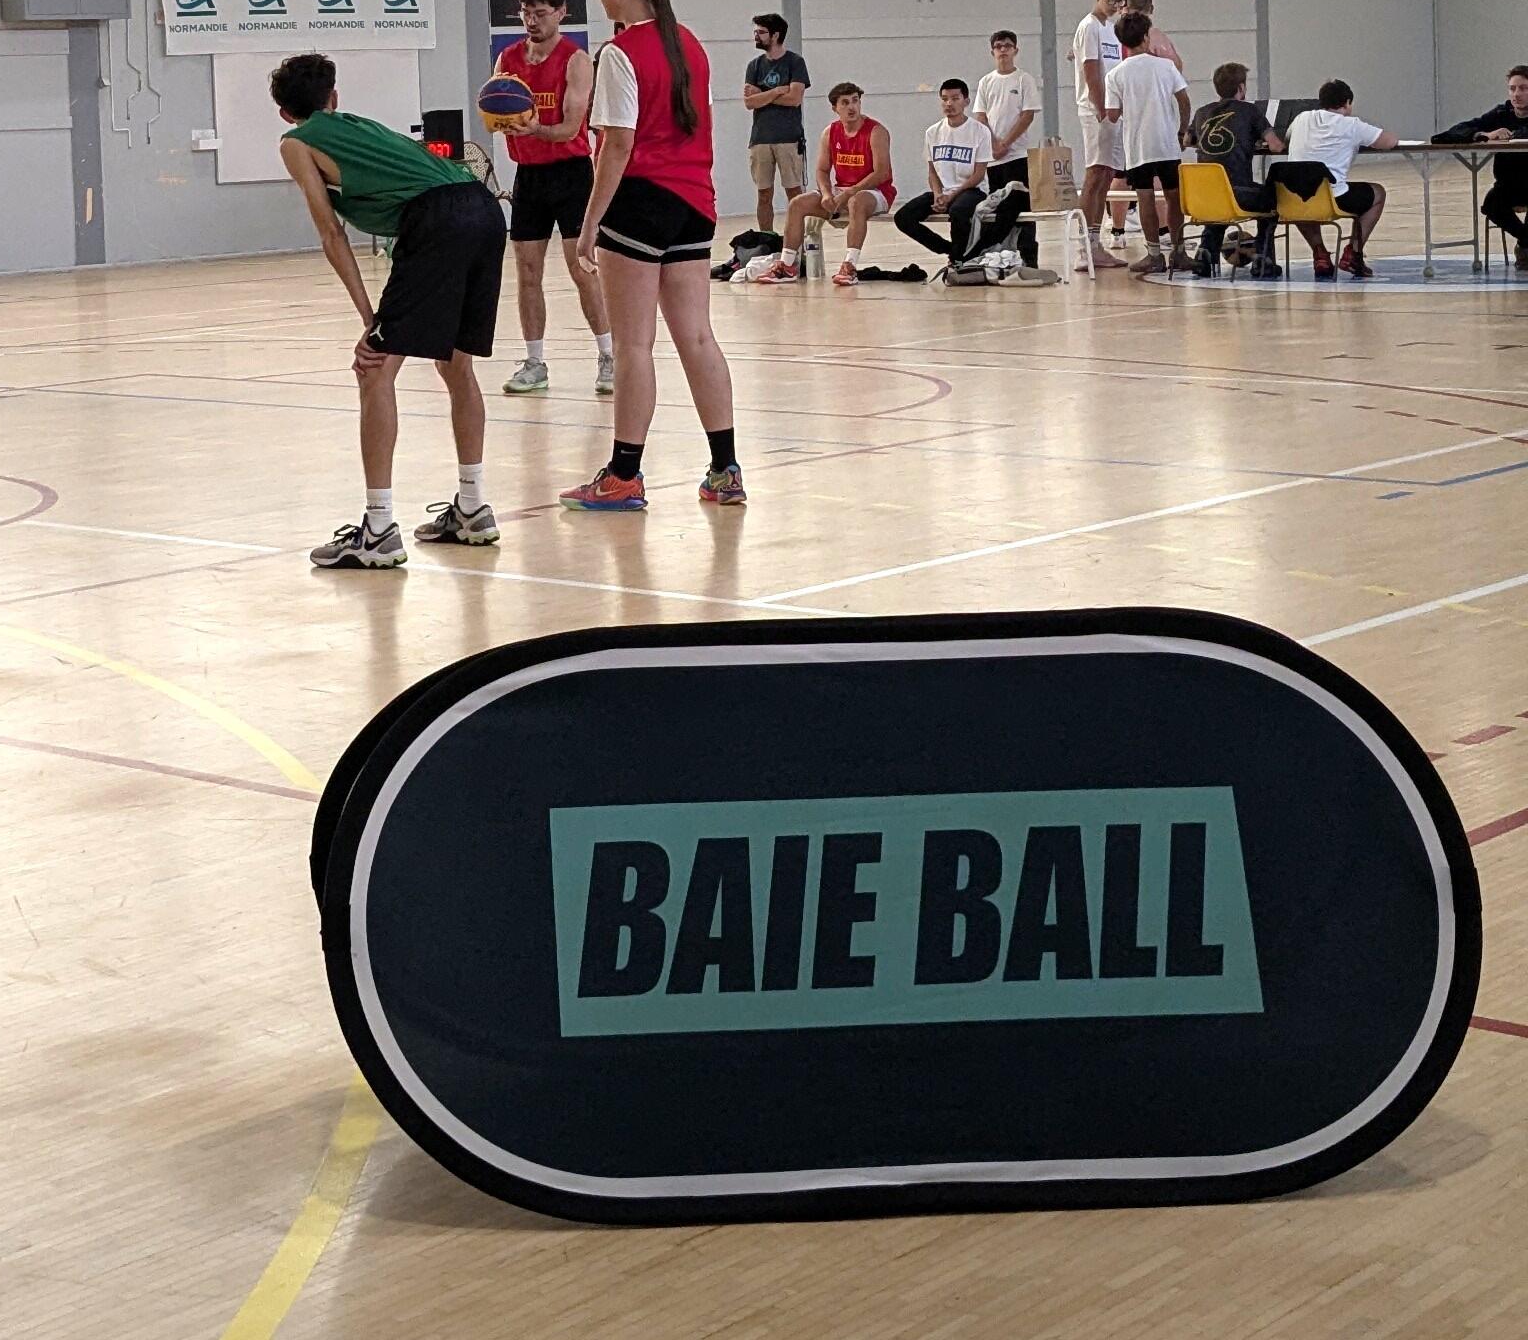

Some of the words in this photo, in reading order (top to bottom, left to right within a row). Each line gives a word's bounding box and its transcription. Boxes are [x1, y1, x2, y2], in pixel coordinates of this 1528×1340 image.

[169, 23, 228, 33] NORMANDIE
[238, 21, 297, 31] NORMANDIE
[308, 20, 365, 29] NORMANDIE
[374, 20, 429, 29] NORMANDIE
[576, 831, 884, 999] BAIE
[913, 821, 1225, 986] BALL
